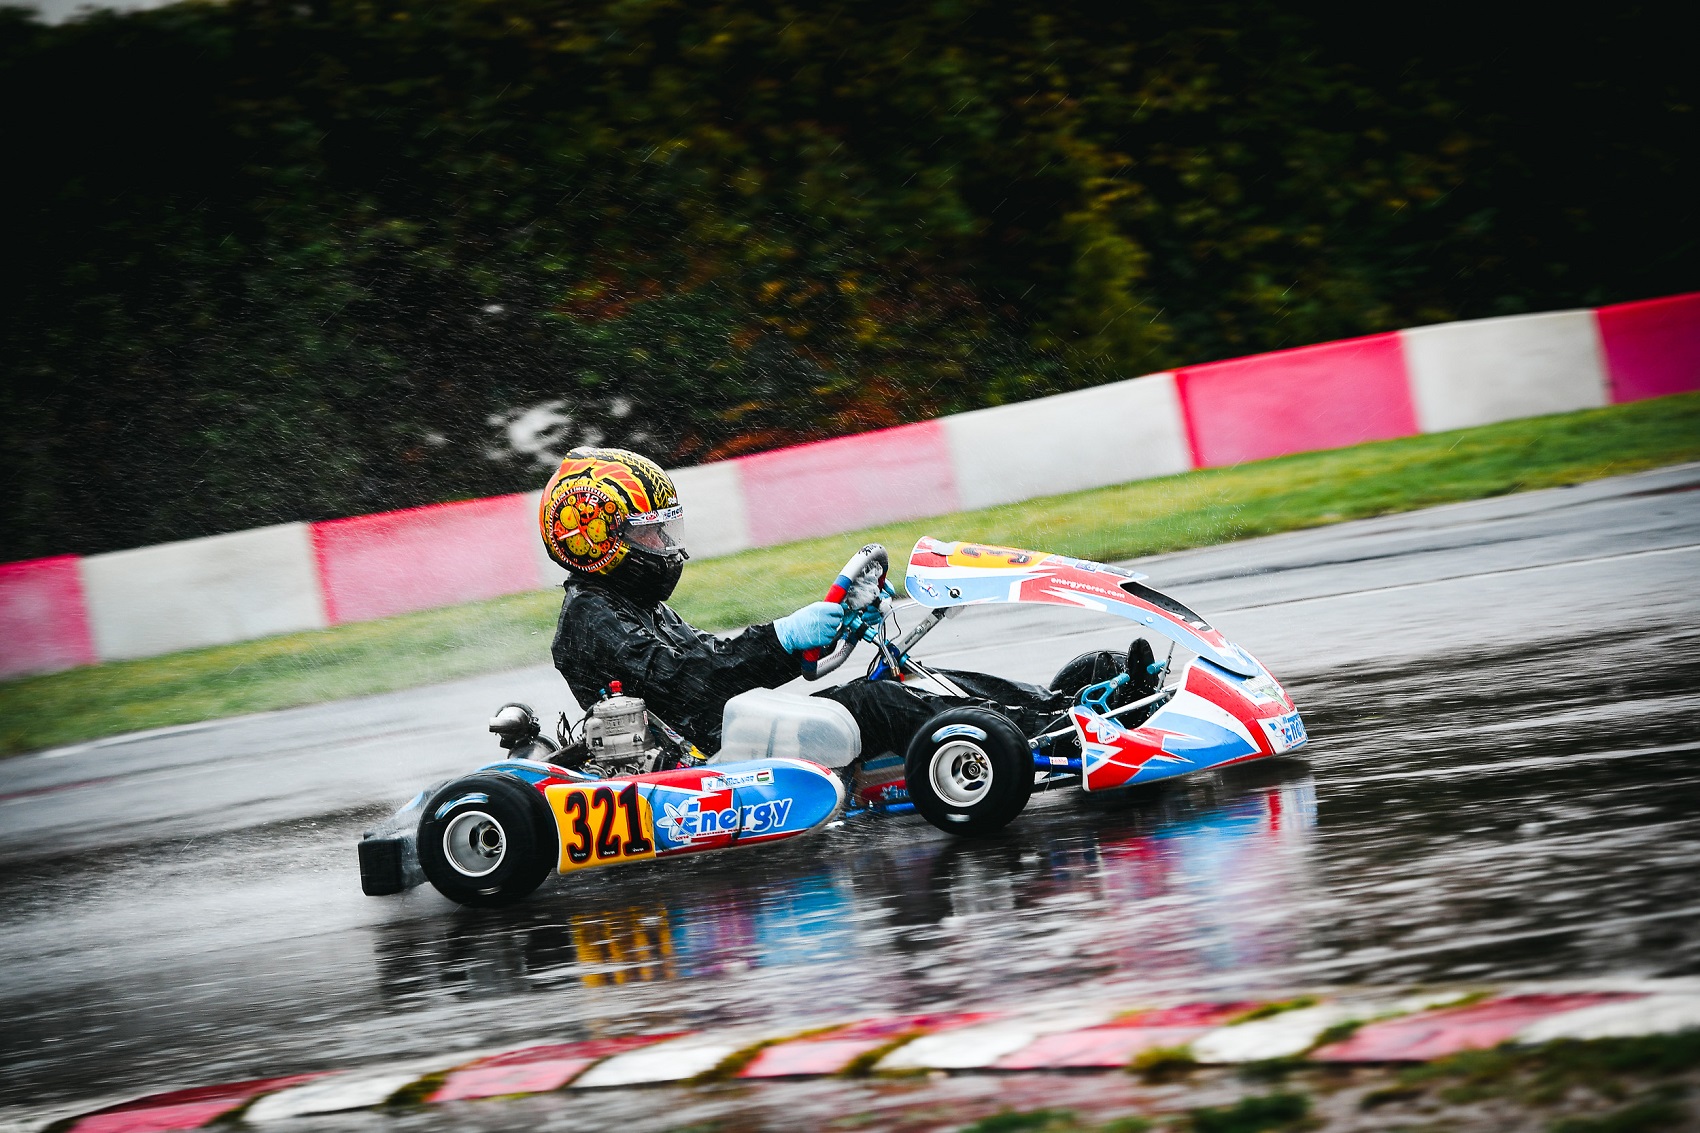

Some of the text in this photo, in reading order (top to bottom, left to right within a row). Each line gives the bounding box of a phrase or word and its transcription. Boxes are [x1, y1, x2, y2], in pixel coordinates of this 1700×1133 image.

[1050, 577, 1126, 599] energycorse.com
[564, 782, 653, 864] 321
[677, 798, 793, 837] Energy
